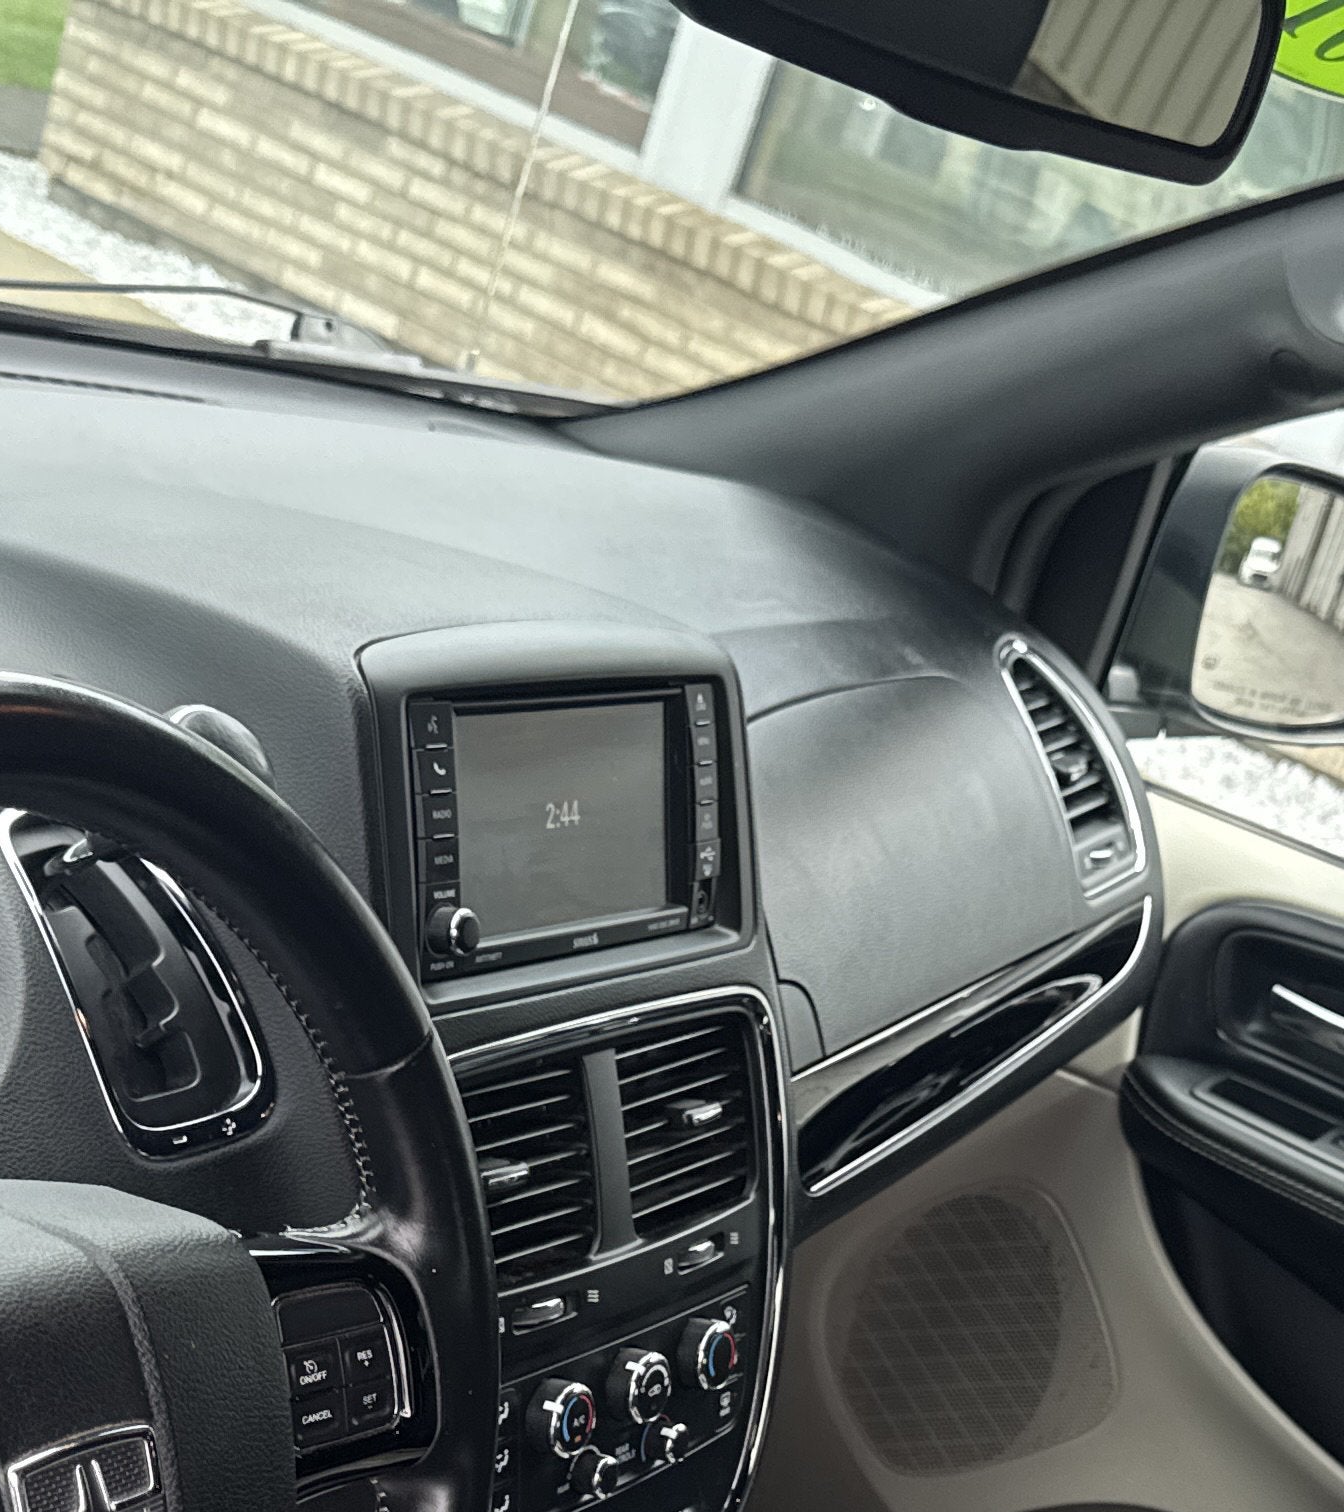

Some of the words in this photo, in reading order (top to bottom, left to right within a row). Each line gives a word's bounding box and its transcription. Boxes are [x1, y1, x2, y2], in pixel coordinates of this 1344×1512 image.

[546, 800, 581, 829] 2:44
[357, 1349, 373, 1361] RES
[299, 1370, 327, 1386] ON/OFF
[362, 1393, 377, 1405] SET
[302, 1409, 333, 1425] CANCEL
